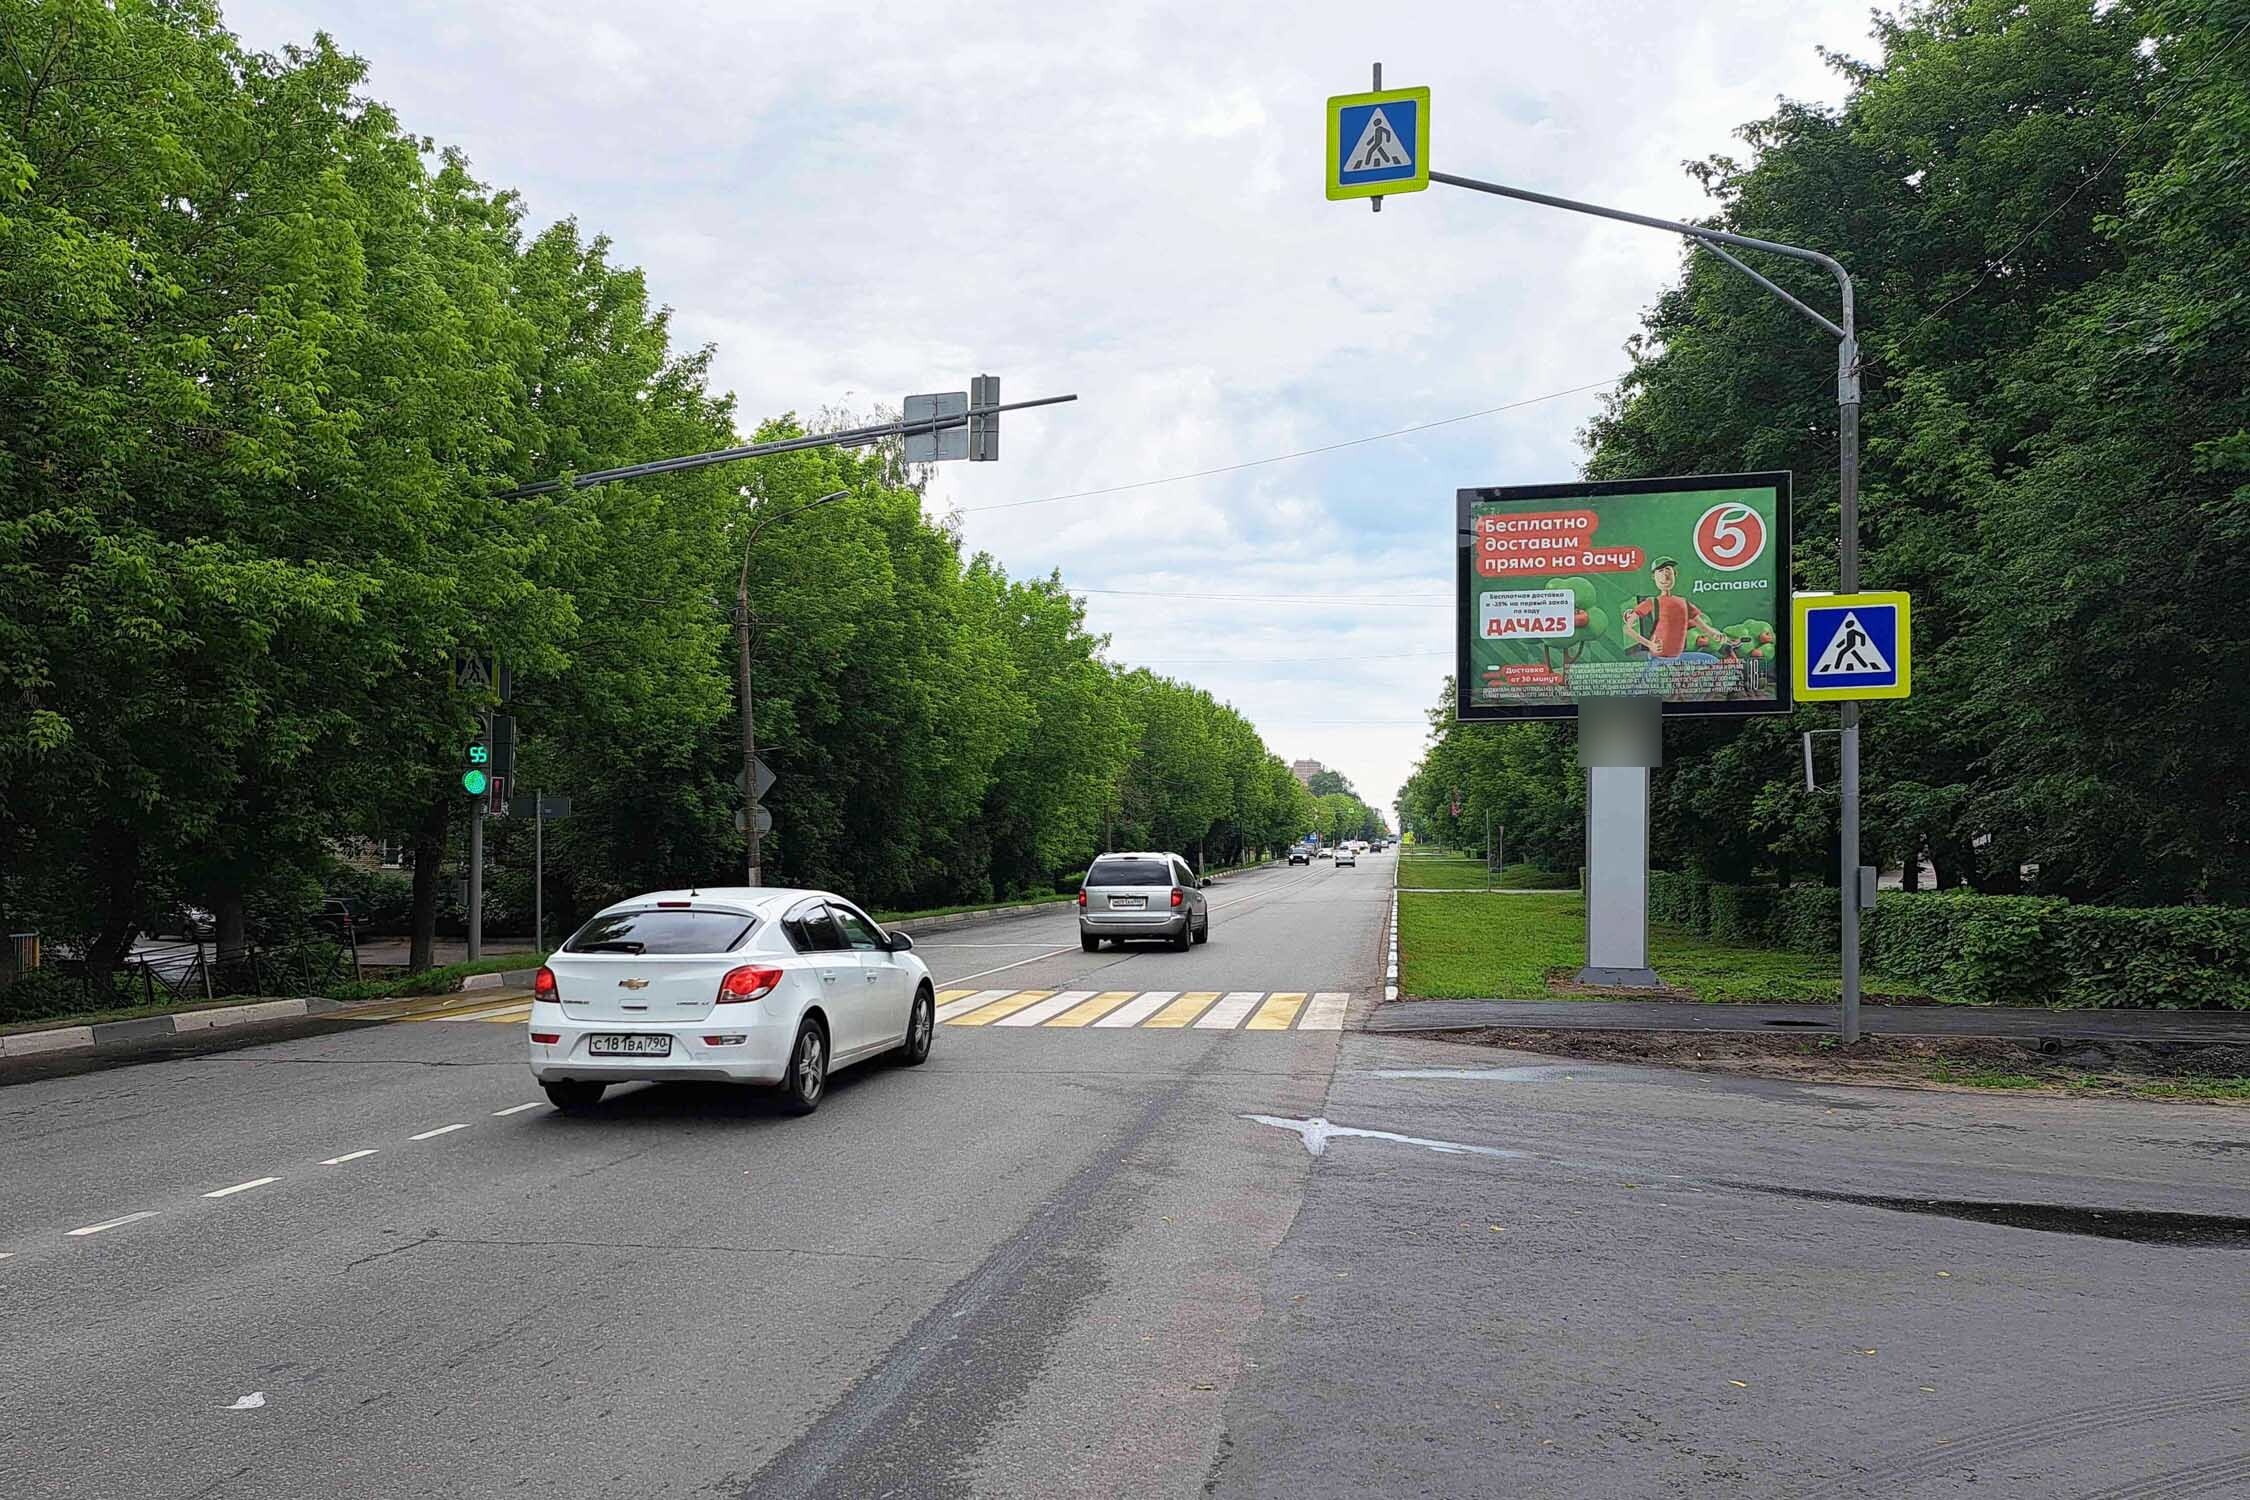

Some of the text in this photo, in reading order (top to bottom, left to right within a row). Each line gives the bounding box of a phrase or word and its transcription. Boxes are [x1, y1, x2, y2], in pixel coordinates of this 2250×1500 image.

[1485, 517, 1588, 532] Бесплатно
[1712, 507, 1750, 558] 5
[1485, 536, 1578, 551] доставим
[1485, 551, 1636, 572] прямо на дачу!
[1693, 580, 1768, 593] Доставка
[1487, 617, 1567, 636] ДАЧА25
[470, 747, 487, 762] 55
[647, 1036, 667, 1048] 790
